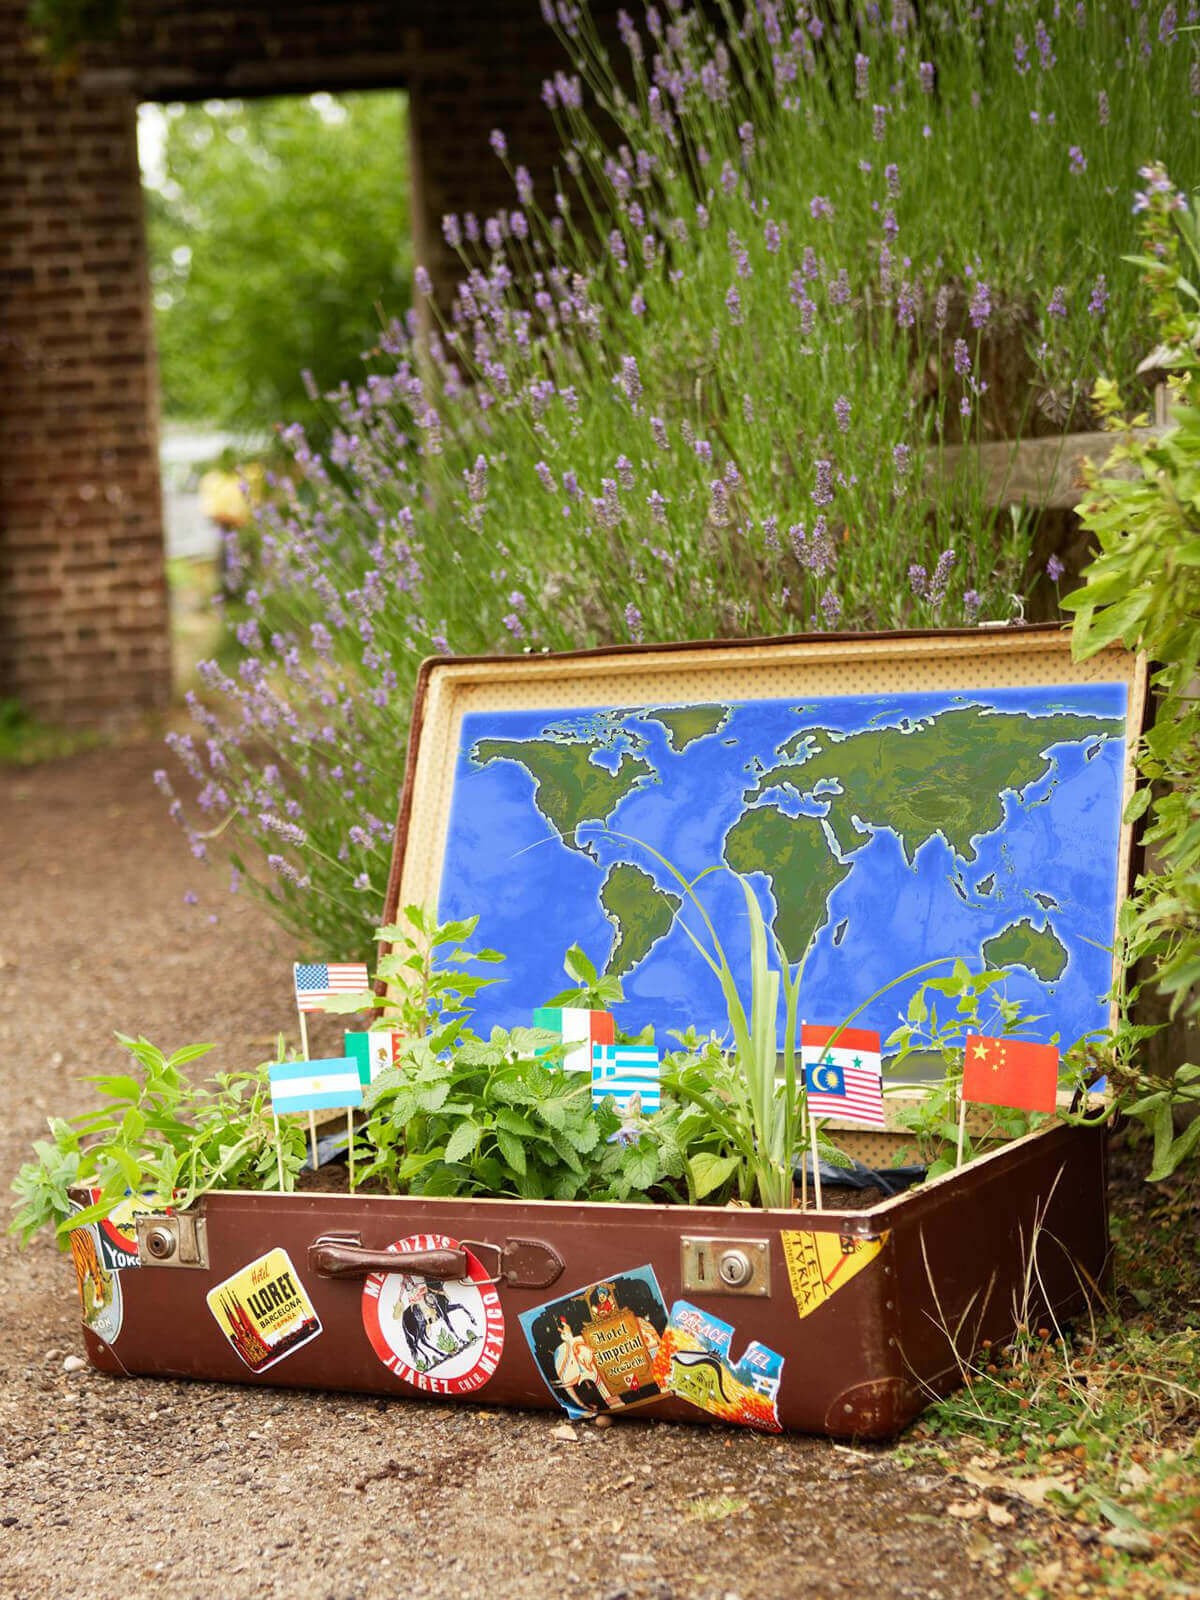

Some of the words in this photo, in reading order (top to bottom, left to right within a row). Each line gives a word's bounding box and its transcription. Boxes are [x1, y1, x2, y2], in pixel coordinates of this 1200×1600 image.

[247, 1272, 297, 1320] LLORET
[259, 1298, 302, 1328] BARCELONA
[676, 1310, 730, 1345] PALACE
[383, 1354, 453, 1394] JUAREZ
[478, 1291, 504, 1376] MEXICO
[593, 1323, 627, 1344] Hotel
[594, 1335, 643, 1365] Imperial
[746, 1349, 771, 1370] TEL
